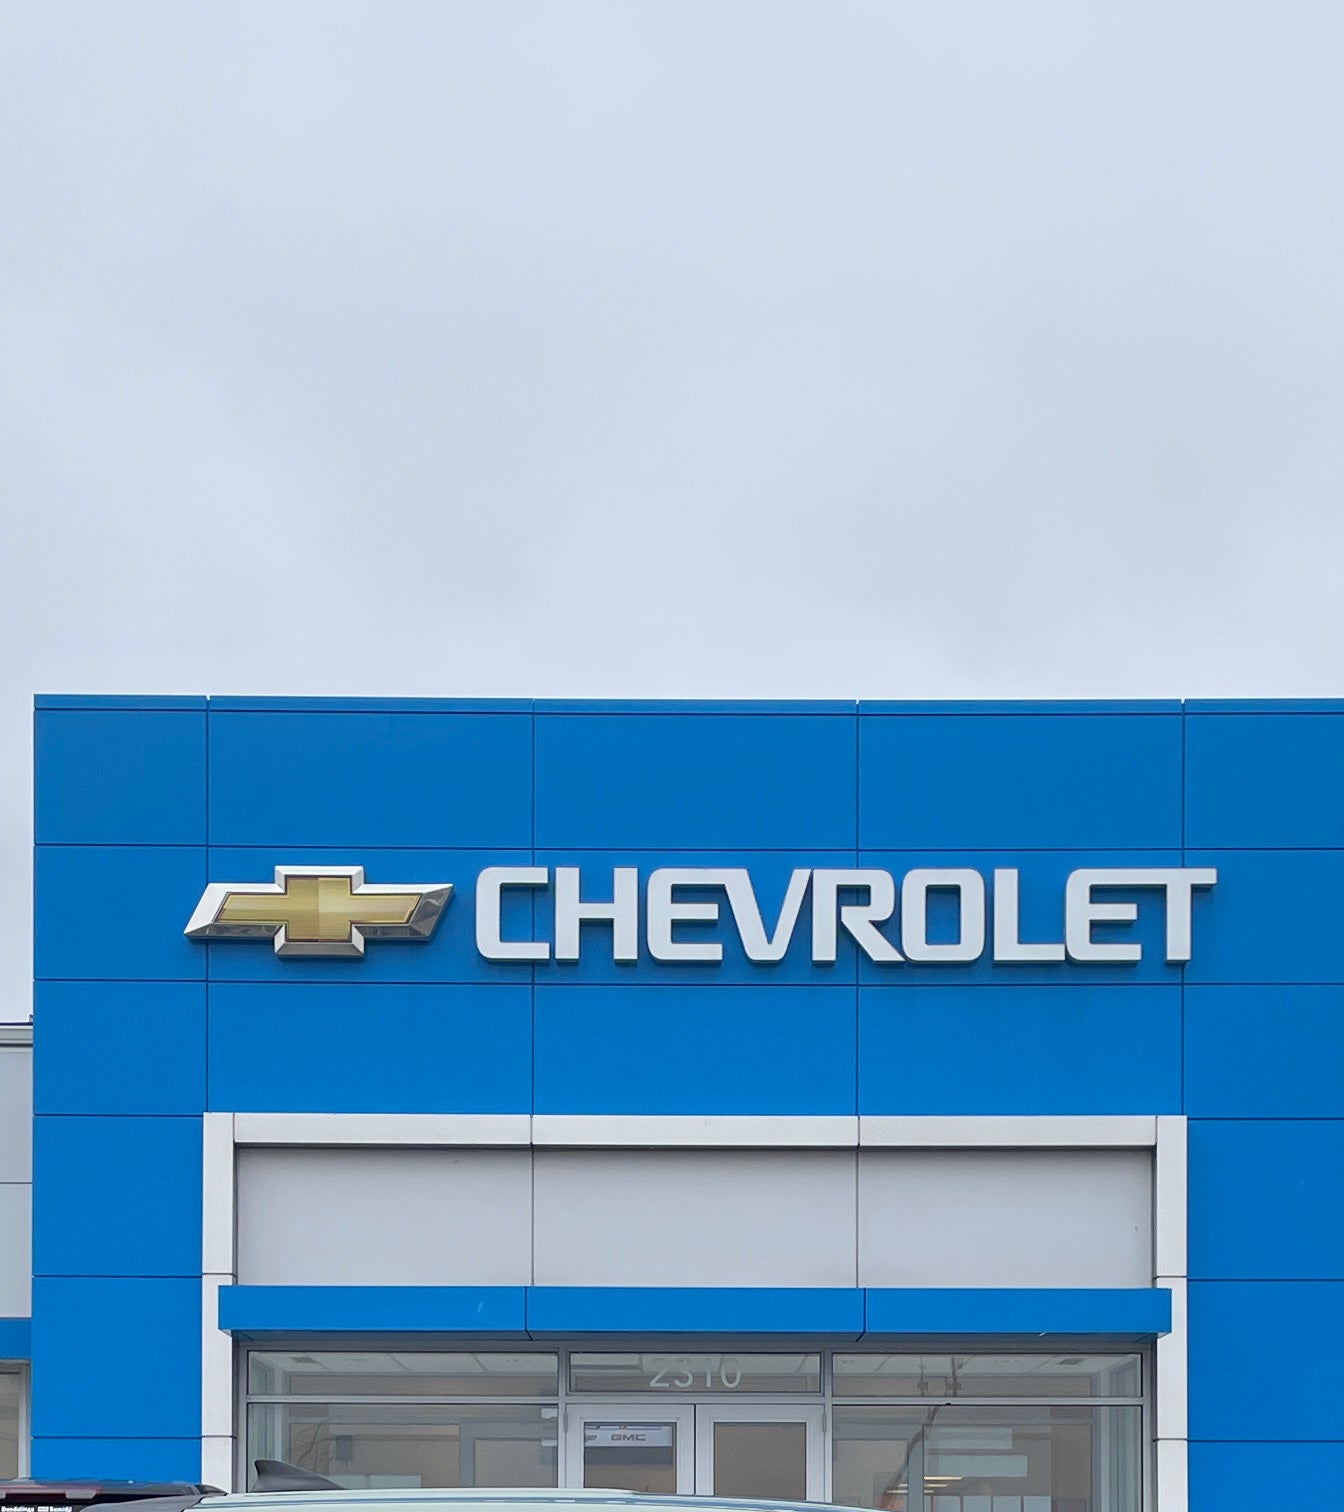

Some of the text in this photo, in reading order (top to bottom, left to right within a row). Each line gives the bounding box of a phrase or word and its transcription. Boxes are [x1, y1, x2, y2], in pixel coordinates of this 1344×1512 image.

[475, 866, 1218, 965] CHEVROLET
[649, 1357, 743, 1389] 2310
[610, 1433, 647, 1442] GMC
